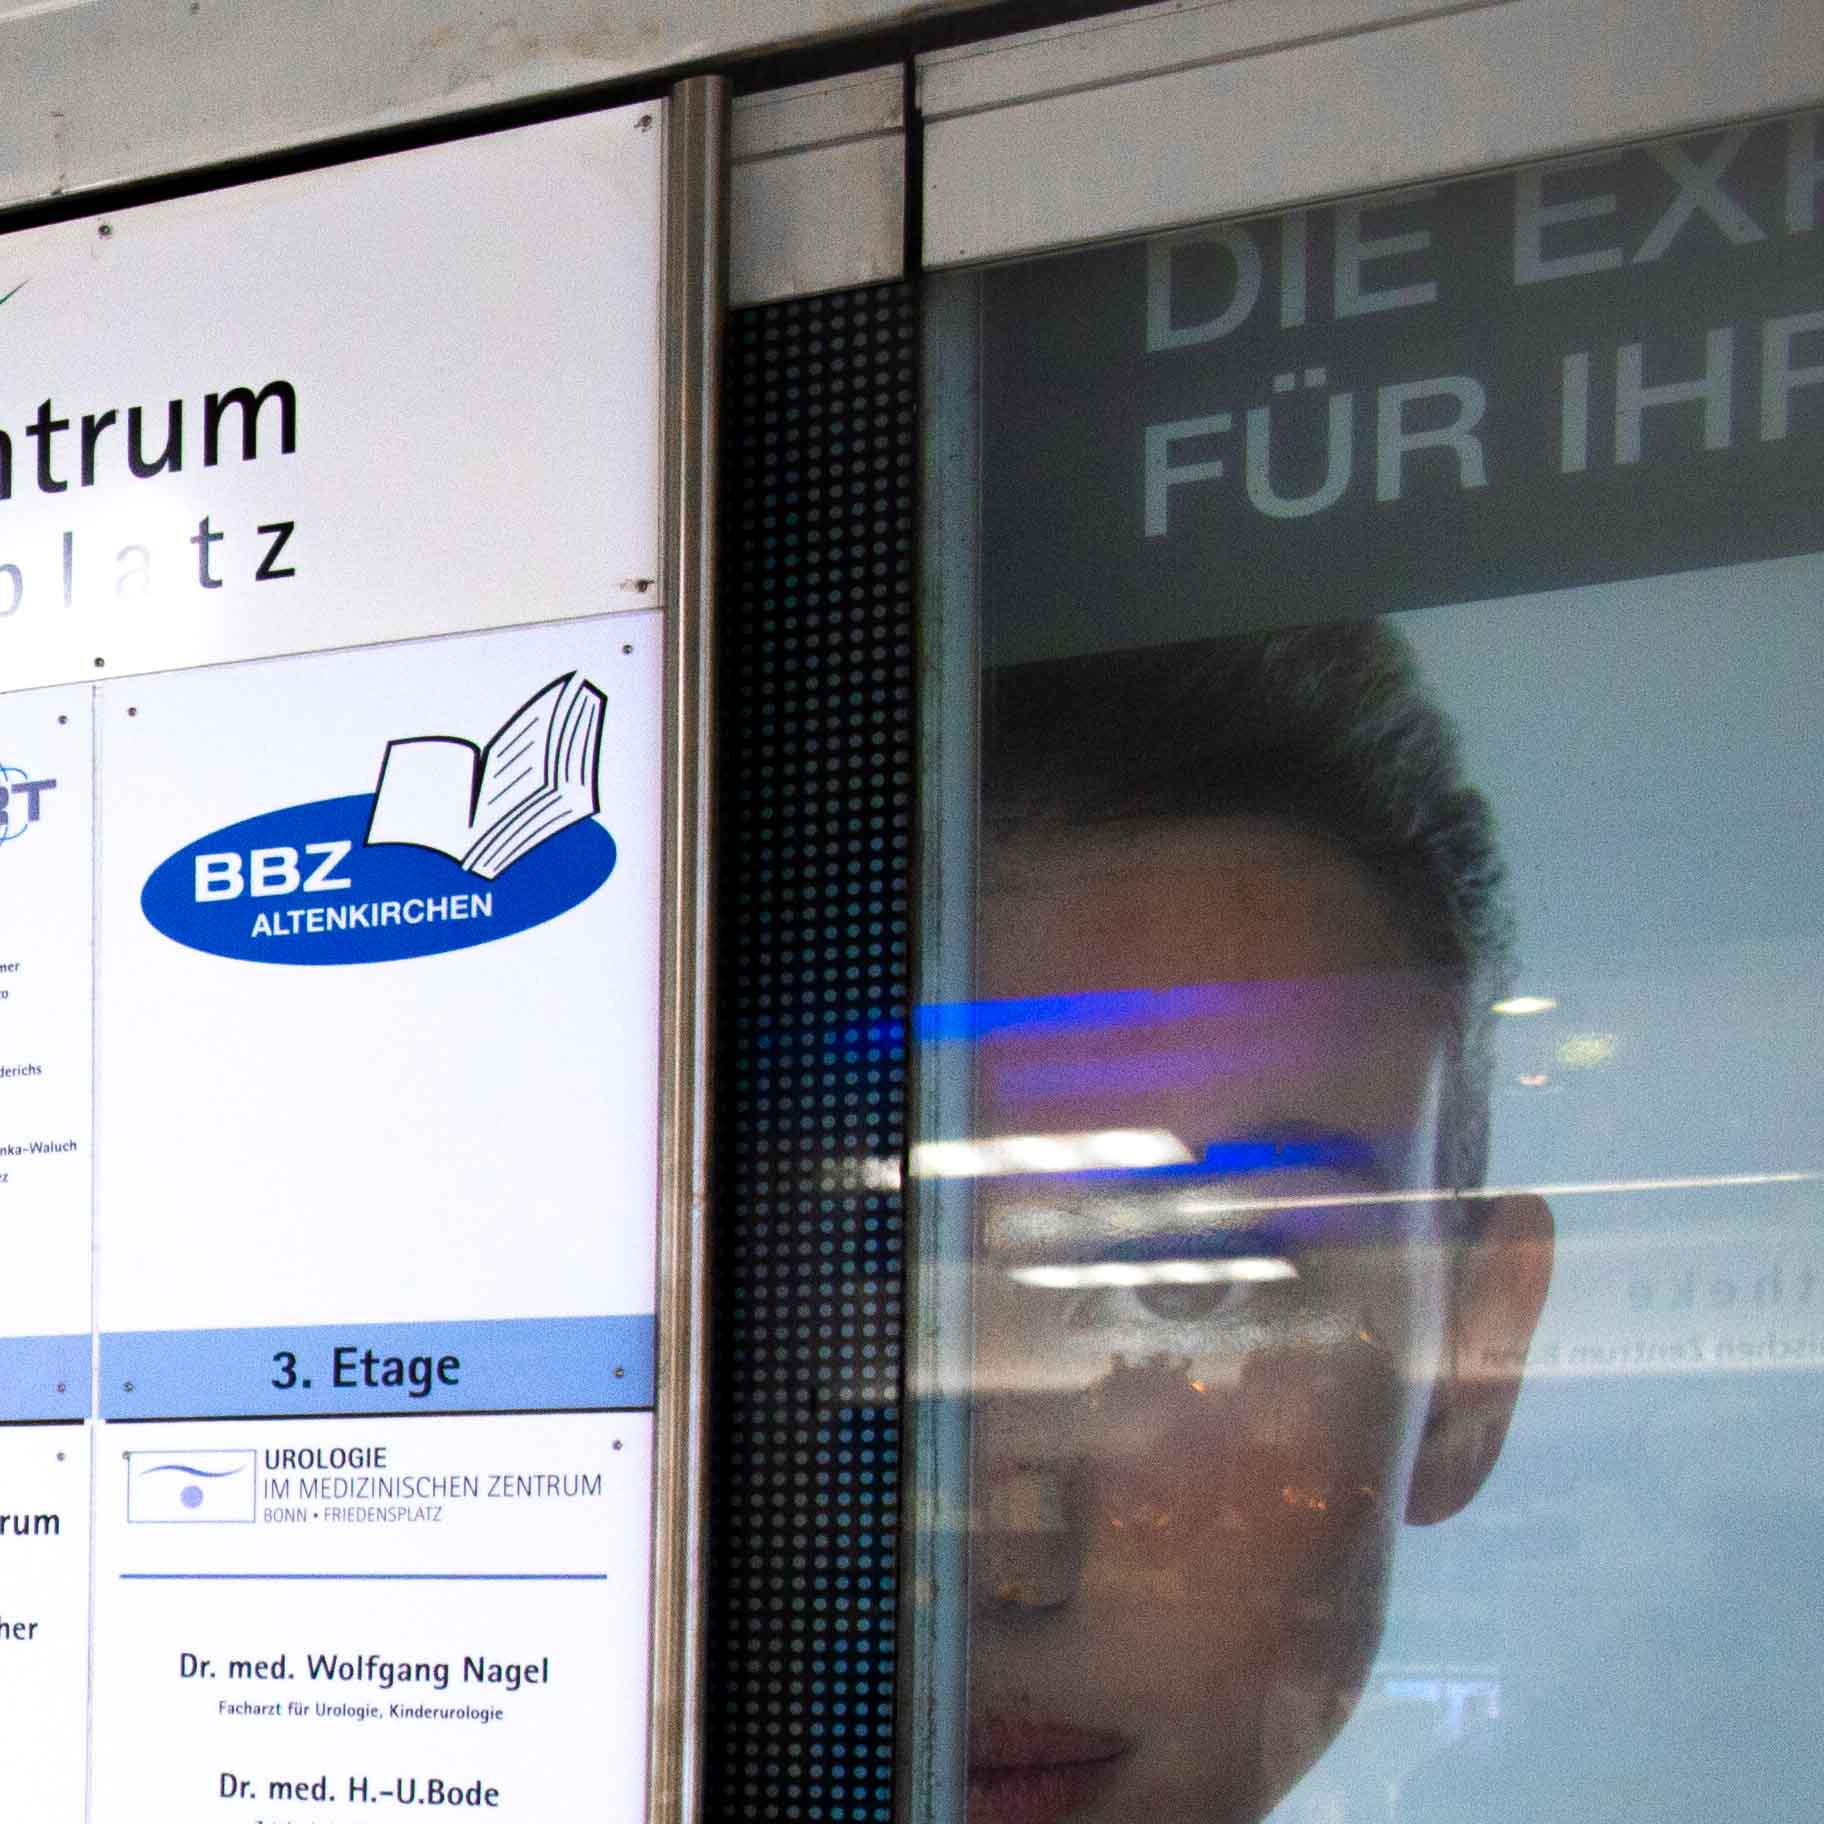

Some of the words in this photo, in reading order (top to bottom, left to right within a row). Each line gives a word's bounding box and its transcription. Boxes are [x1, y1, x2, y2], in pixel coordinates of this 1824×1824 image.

[1147, 194, 1439, 352] DIE
[1513, 112, 1824, 286] EX
[1145, 366, 1489, 536] FÜR
[195, 840, 352, 903] BBZ
[251, 892, 493, 938] ALTENKIRCHEN
[271, 1351, 312, 1390] 3.
[333, 1346, 461, 1399] Etage
[265, 1446, 386, 1470] UROLOGIE
[264, 1478, 290, 1500] IM
[299, 1475, 479, 1499] MEDIZINISCHEN
[487, 1473, 602, 1498] ZENTRUM
[264, 1507, 307, 1523] BONN
[324, 1505, 443, 1523] FRIEDENSPLATZ
[180, 1652, 216, 1679] Dr.
[229, 1654, 294, 1680] med.
[307, 1654, 449, 1690] Wolfgang
[463, 1656, 549, 1692] Nagel
[218, 1700, 282, 1716] Facharzt
[287, 1701, 310, 1716] für
[315, 1702, 383, 1721] Urologie,
[389, 1704, 504, 1724] Kinderurologie
